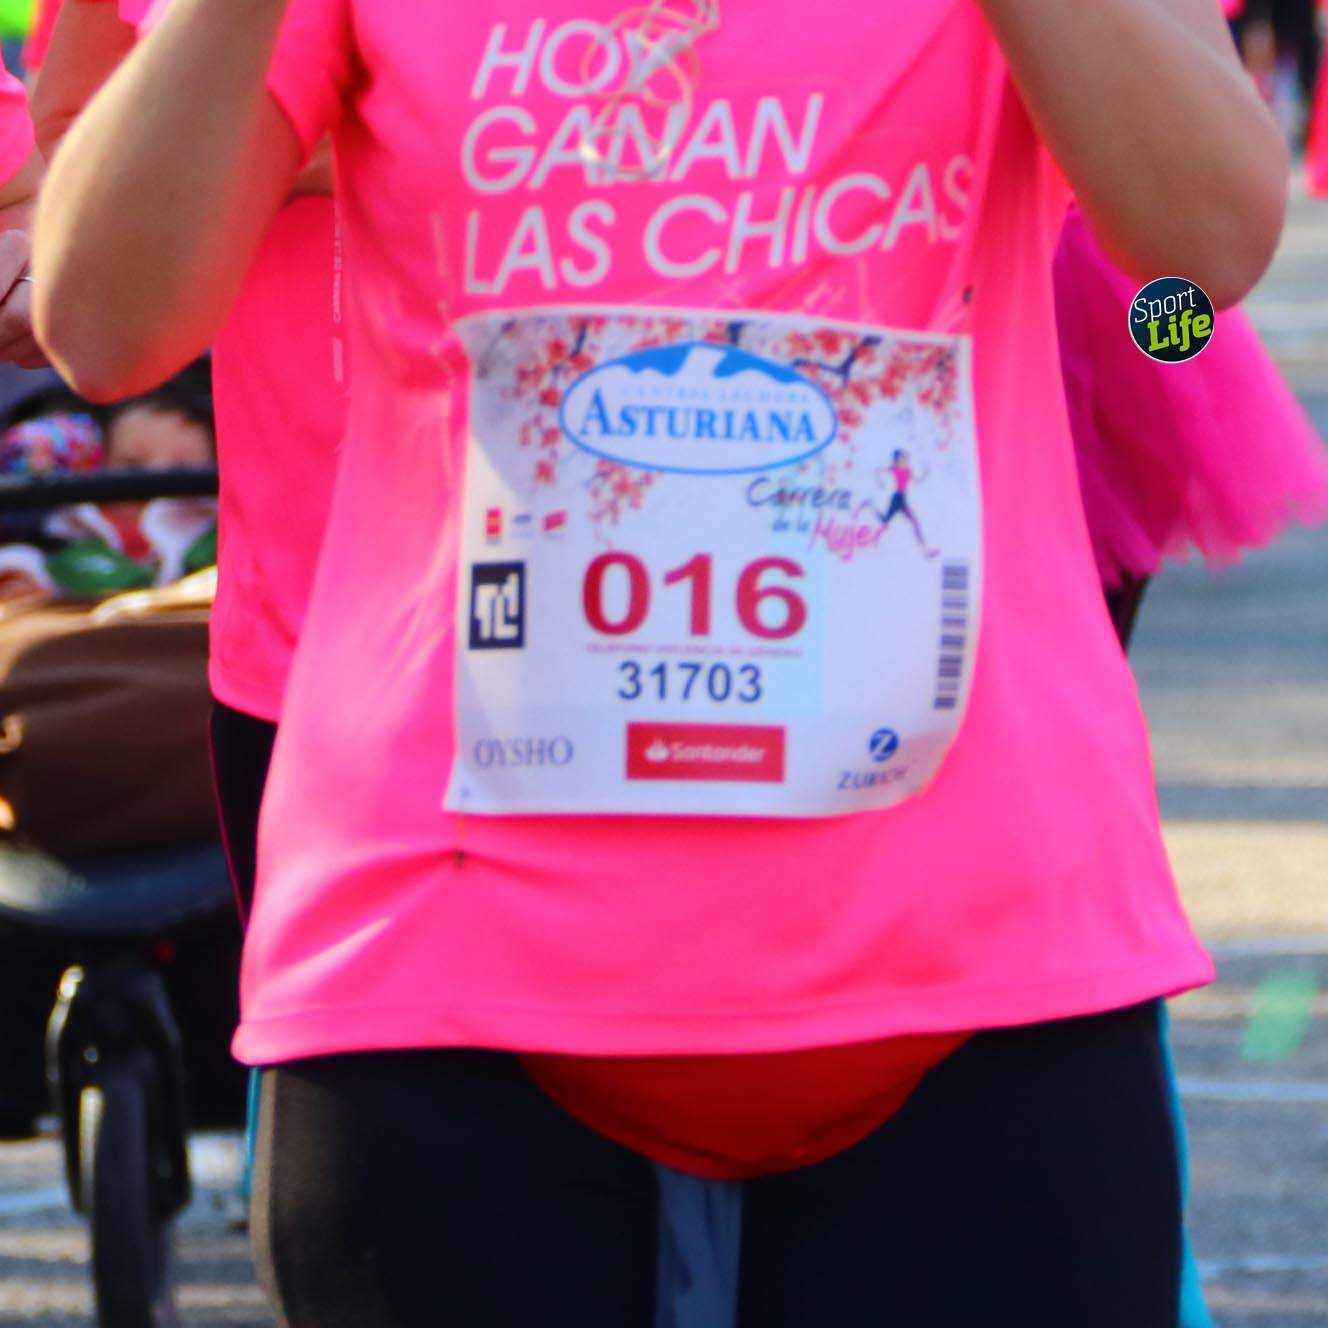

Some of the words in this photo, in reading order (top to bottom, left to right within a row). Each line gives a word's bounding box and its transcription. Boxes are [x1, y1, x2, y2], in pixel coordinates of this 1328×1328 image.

[471, 19, 696, 100] HOY
[461, 91, 823, 194] GANAN
[464, 202, 615, 295] LAS
[643, 154, 976, 276] CHICAS
[579, 386, 816, 442] ASTURIANA
[747, 476, 852, 508] Carrera
[808, 511, 890, 561] Mujer
[581, 550, 808, 640] 016
[617, 660, 763, 703] 31703
[473, 736, 575, 768] OYSHO
[672, 741, 766, 764] Santander
[837, 766, 911, 791] ZURICH
